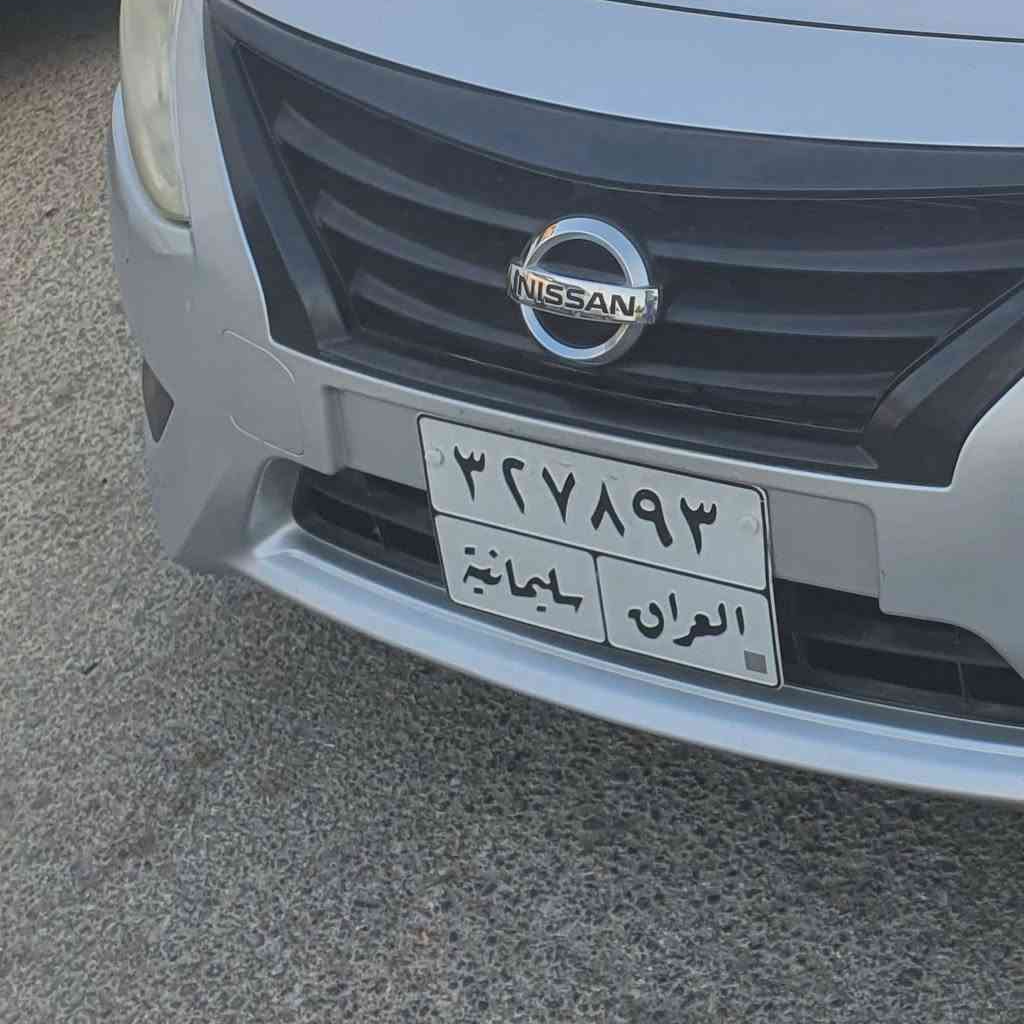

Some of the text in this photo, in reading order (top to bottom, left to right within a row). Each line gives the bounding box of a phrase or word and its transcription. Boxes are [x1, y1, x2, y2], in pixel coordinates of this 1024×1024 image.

[517, 276, 636, 317] NISSAN
[454, 445, 718, 555] ٣٢٧٨٩٣
[628, 592, 745, 647] العراق
